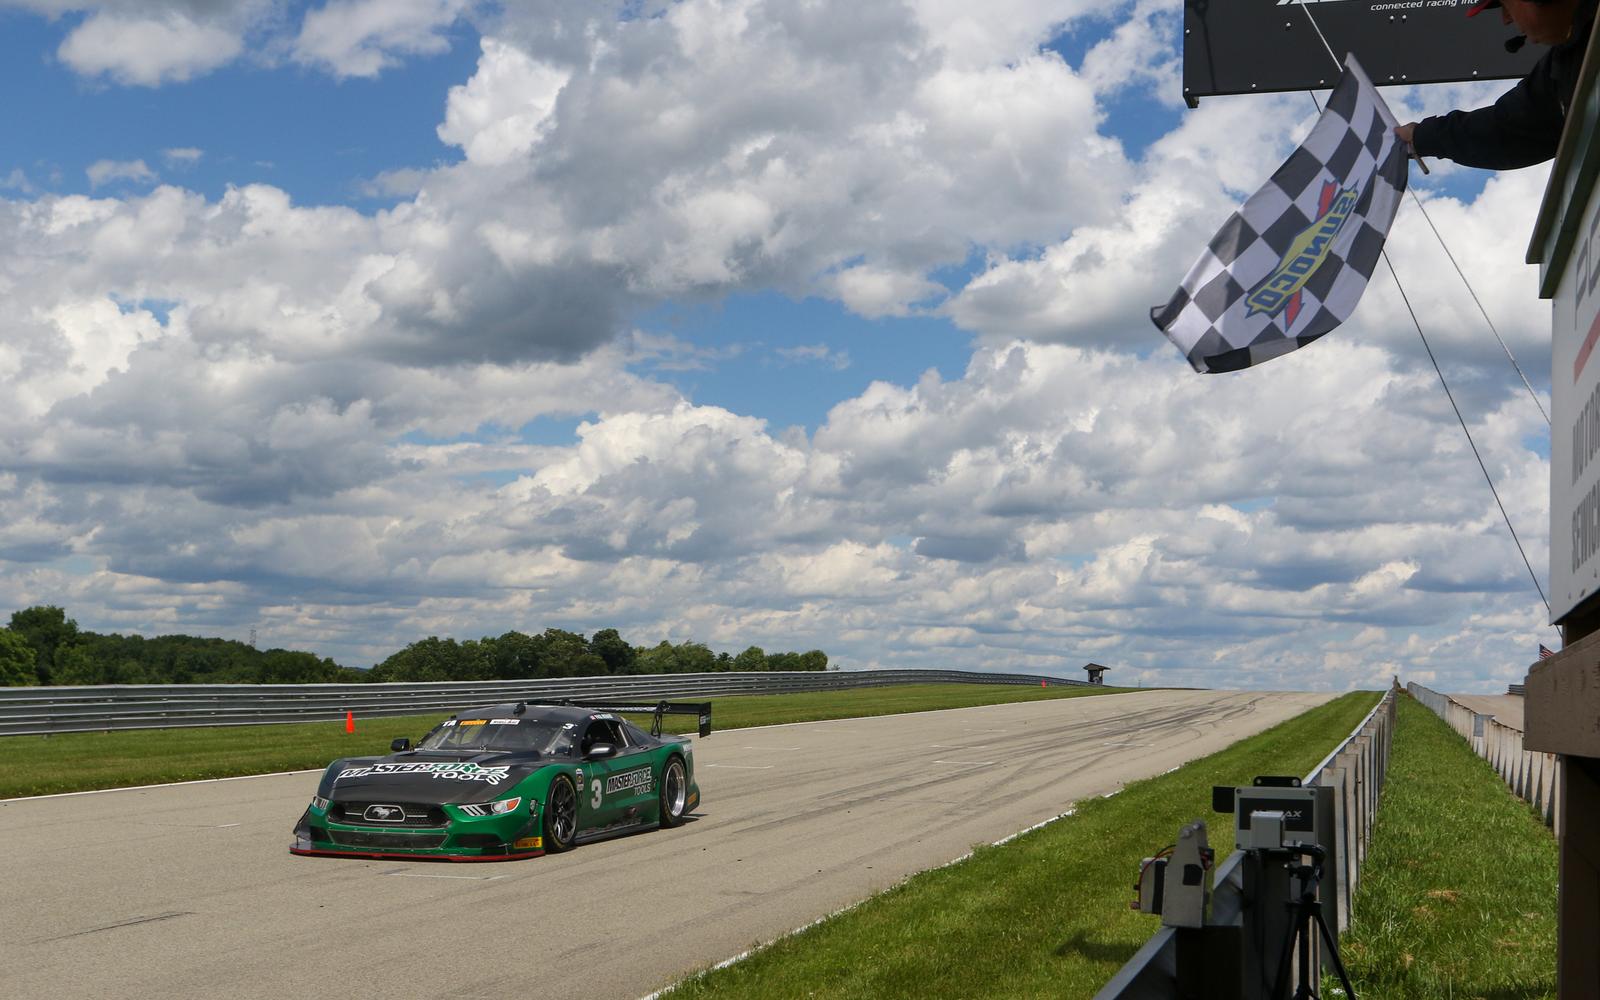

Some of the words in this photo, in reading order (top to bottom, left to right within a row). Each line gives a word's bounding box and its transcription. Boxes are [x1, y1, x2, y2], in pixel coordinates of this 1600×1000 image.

[1370, 0, 1423, 11] connected
[1426, 0, 1457, 8] racing
[606, 766, 652, 795] MASTERFORCE
[634, 783, 651, 796] TOOLS
[591, 779, 603, 809] 3
